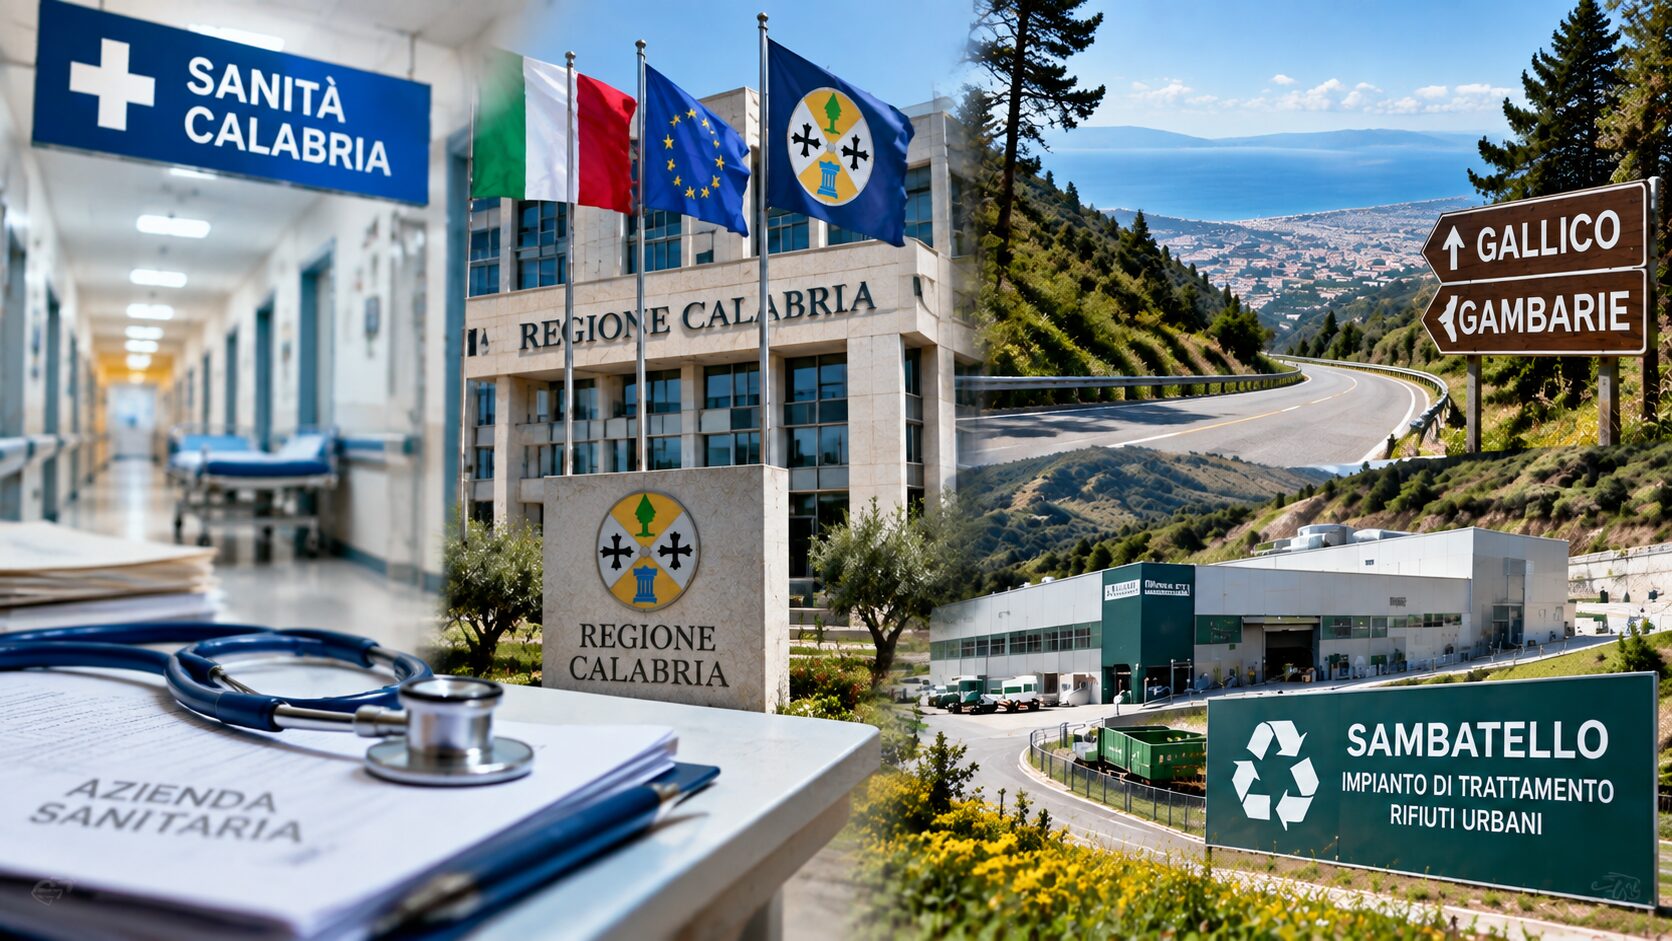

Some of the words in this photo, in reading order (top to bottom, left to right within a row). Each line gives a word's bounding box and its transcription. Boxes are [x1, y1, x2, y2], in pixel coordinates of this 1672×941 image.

[187, 57, 345, 123] SANITÀ
[185, 106, 392, 176] CALABRIA
[1476, 209, 1621, 263] GALLICO
[519, 305, 671, 350] REGIONE
[681, 280, 877, 331] CALABRIA
[1459, 290, 1630, 335] GAMBARIE
[579, 622, 716, 652] REGIONE
[568, 655, 730, 688] CALABRIA
[1346, 719, 1609, 760] SAMBATELLO
[66, 778, 276, 812] AZIENDA
[1342, 771, 1427, 795] IMPIANTO
[1433, 774, 1453, 797] DI
[1458, 774, 1615, 804] TRATTAMENTO
[30, 802, 302, 843] SANITARIA
[1390, 804, 1455, 829] RIFIUTI
[1461, 809, 1542, 835] URBANI
